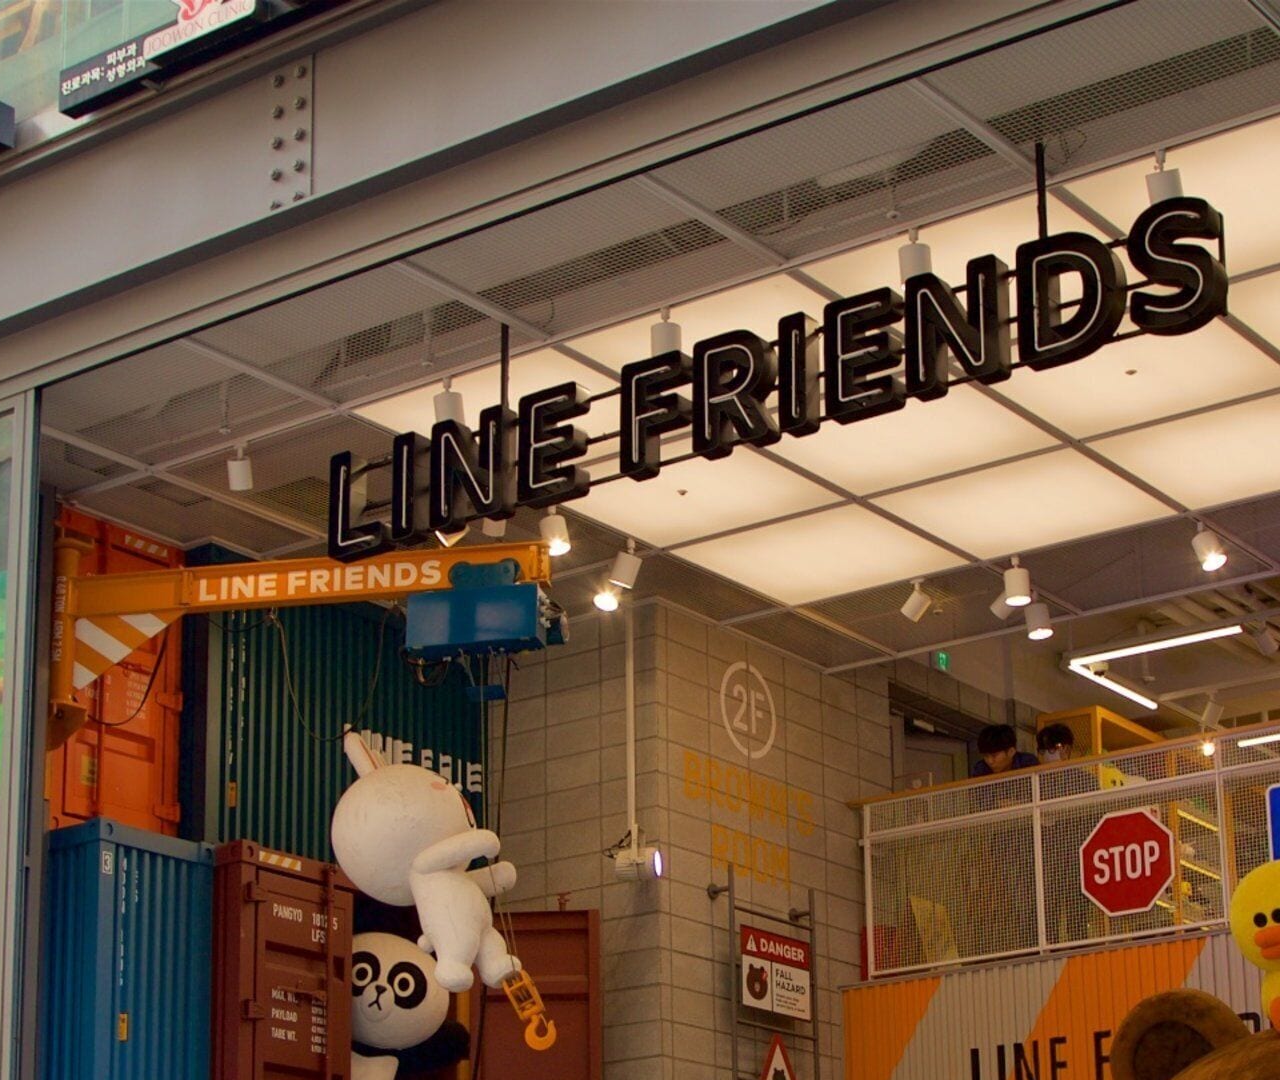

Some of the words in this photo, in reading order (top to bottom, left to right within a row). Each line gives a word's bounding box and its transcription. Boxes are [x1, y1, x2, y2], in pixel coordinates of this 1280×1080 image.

[327, 380, 593, 563] LINE
[619, 197, 1229, 480] FRIENDS
[198, 569, 278, 603] LINE
[286, 558, 442, 597] FRIENDS
[732, 683, 766, 735] 2F
[682, 748, 816, 839] BROWN'S
[102, 852, 113, 872] 3
[711, 822, 793, 893] ROOM
[1092, 839, 1161, 887] STOP
[272, 902, 303, 924] PANGYO
[758, 936, 806, 965] DANGER
[774, 967, 794, 983] FALL
[774, 979, 807, 997] HAZARD
